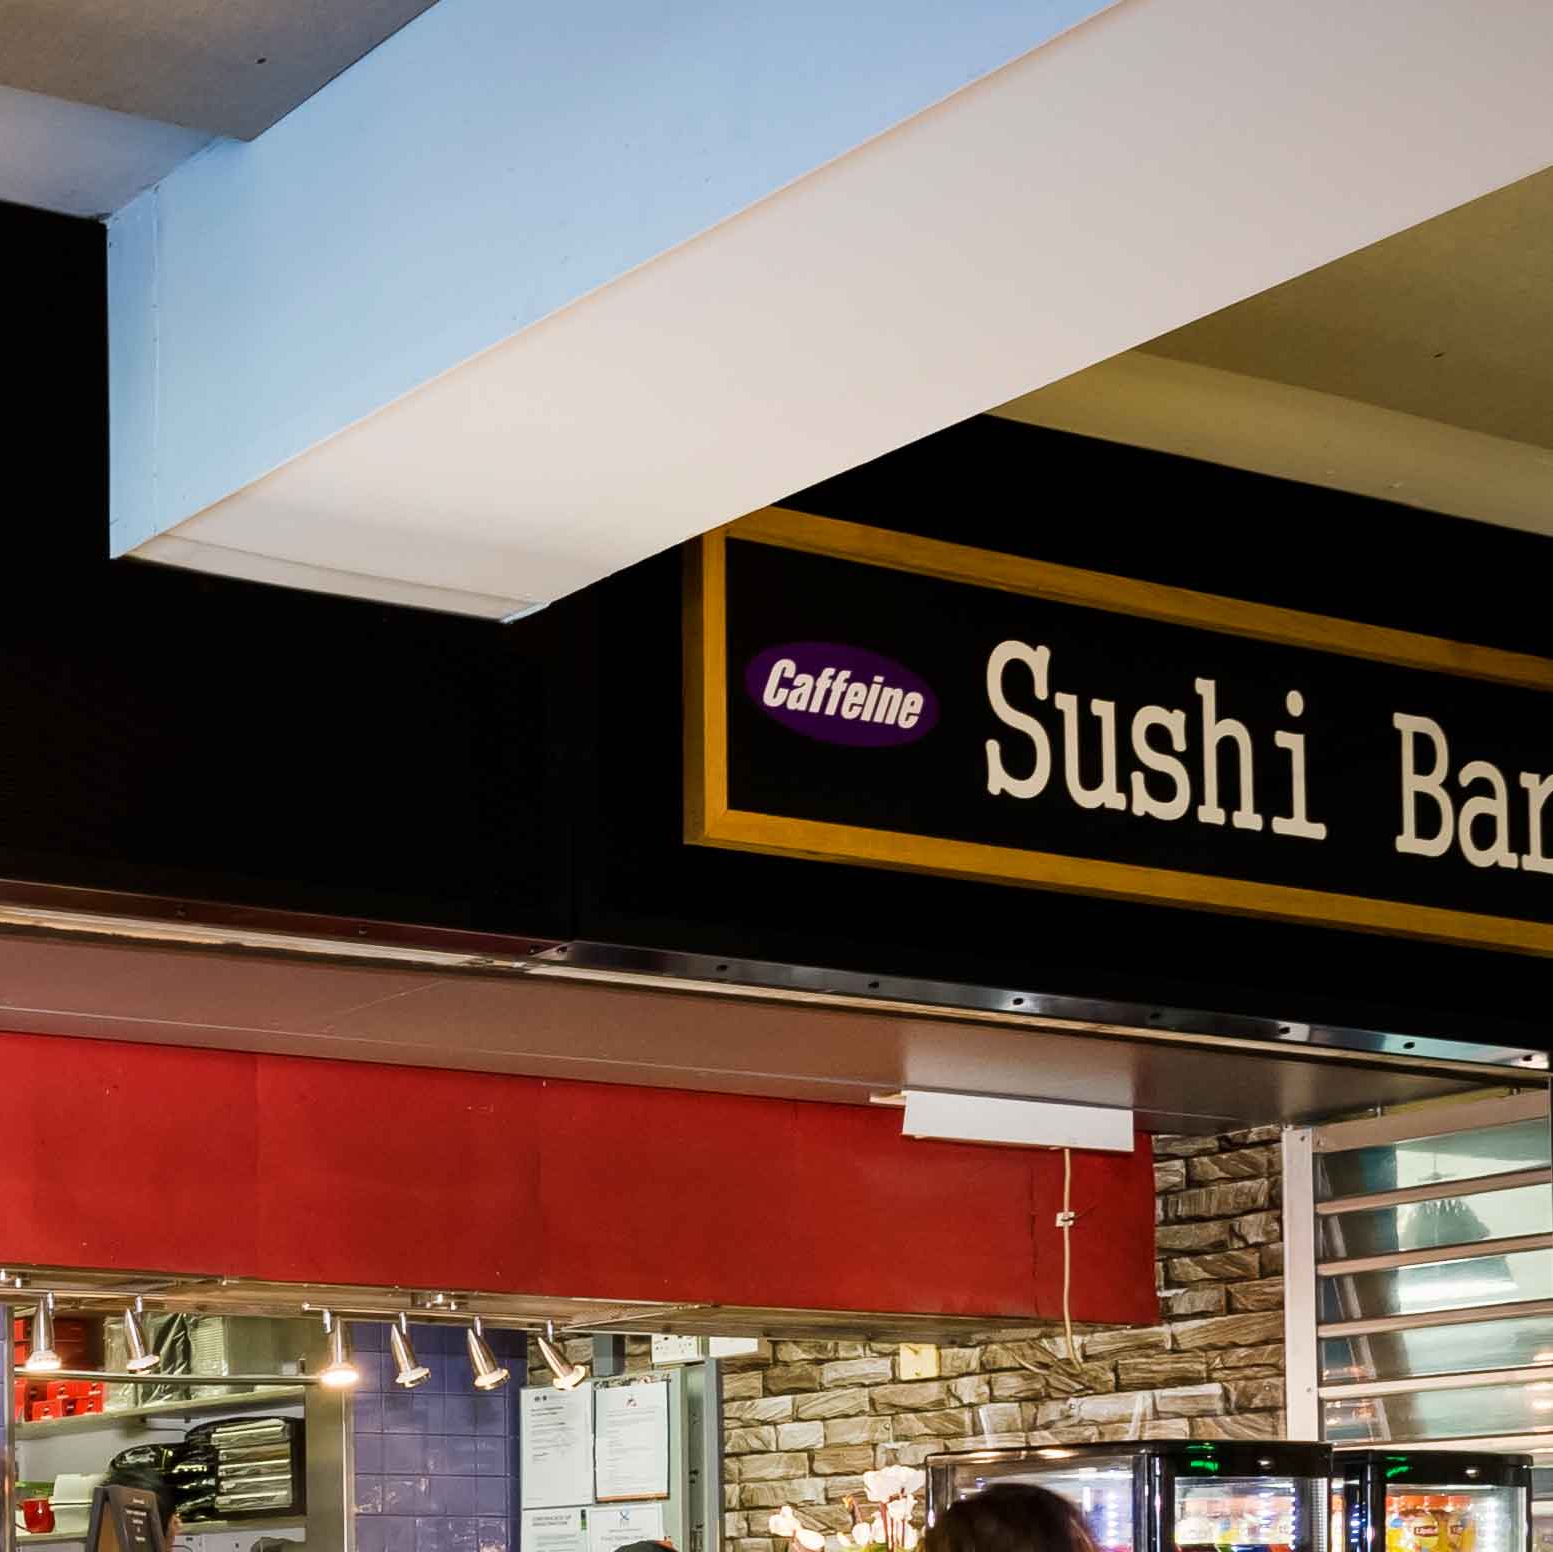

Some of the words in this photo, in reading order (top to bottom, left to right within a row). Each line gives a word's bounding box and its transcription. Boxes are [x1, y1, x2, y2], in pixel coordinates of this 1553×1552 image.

[762, 658, 924, 729] Caffeine
[985, 640, 1327, 840] Sushi
[1393, 712, 1553, 874] Bar
